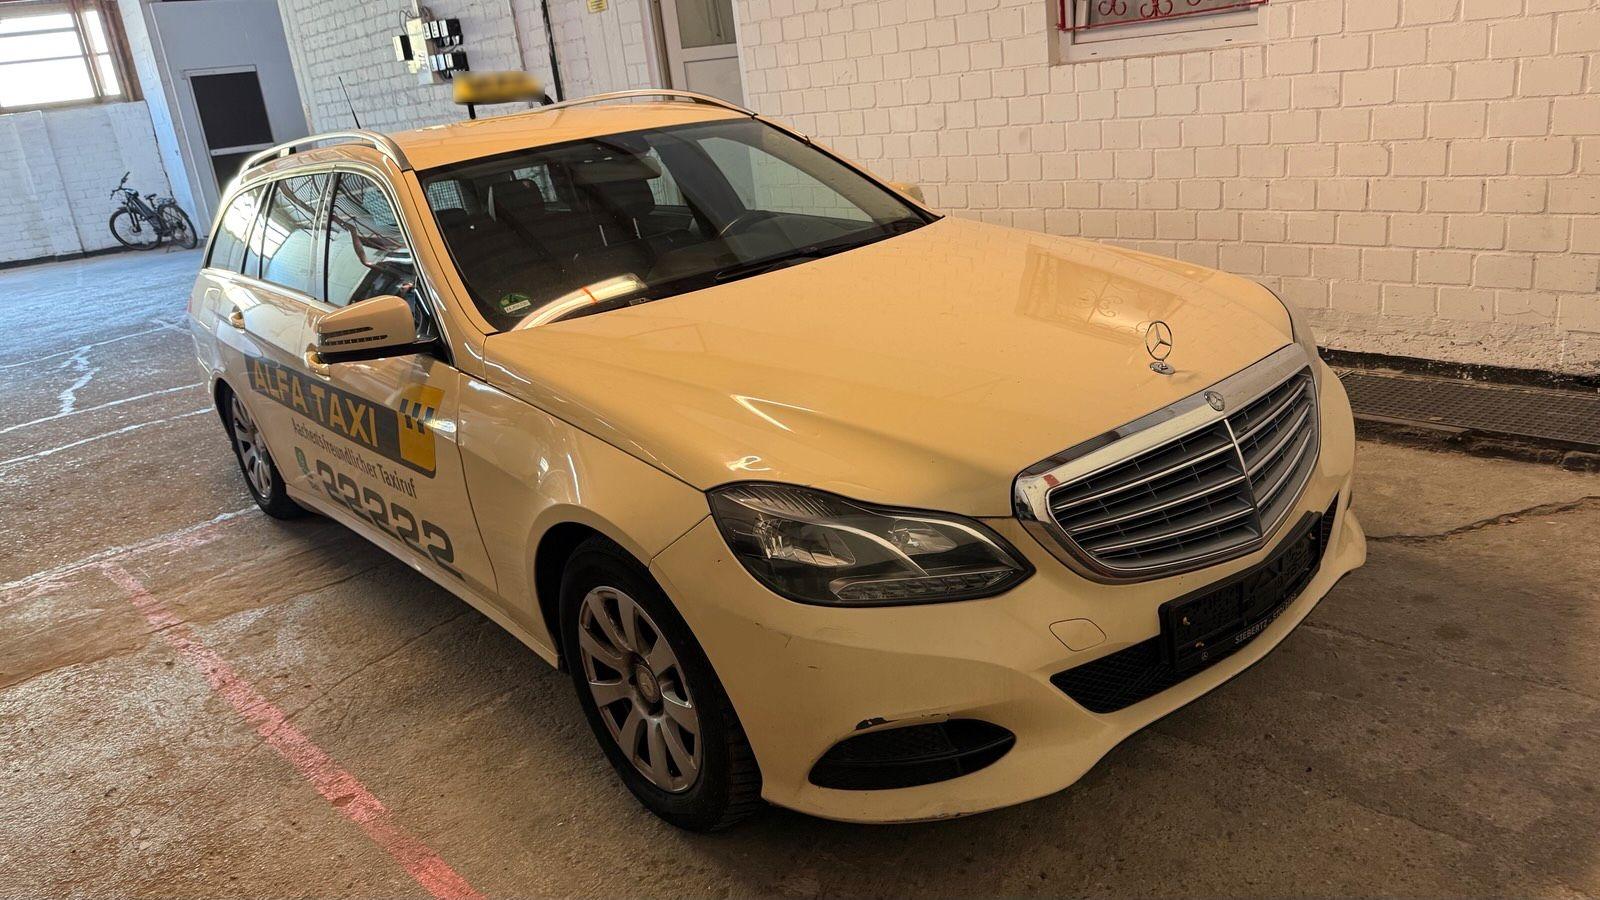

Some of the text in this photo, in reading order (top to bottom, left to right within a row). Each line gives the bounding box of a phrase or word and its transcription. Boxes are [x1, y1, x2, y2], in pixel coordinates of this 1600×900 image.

[253, 359, 378, 448] ALFA TAXI
[316, 459, 466, 582] 22222
[377, 463, 417, 499] Taxiruf
